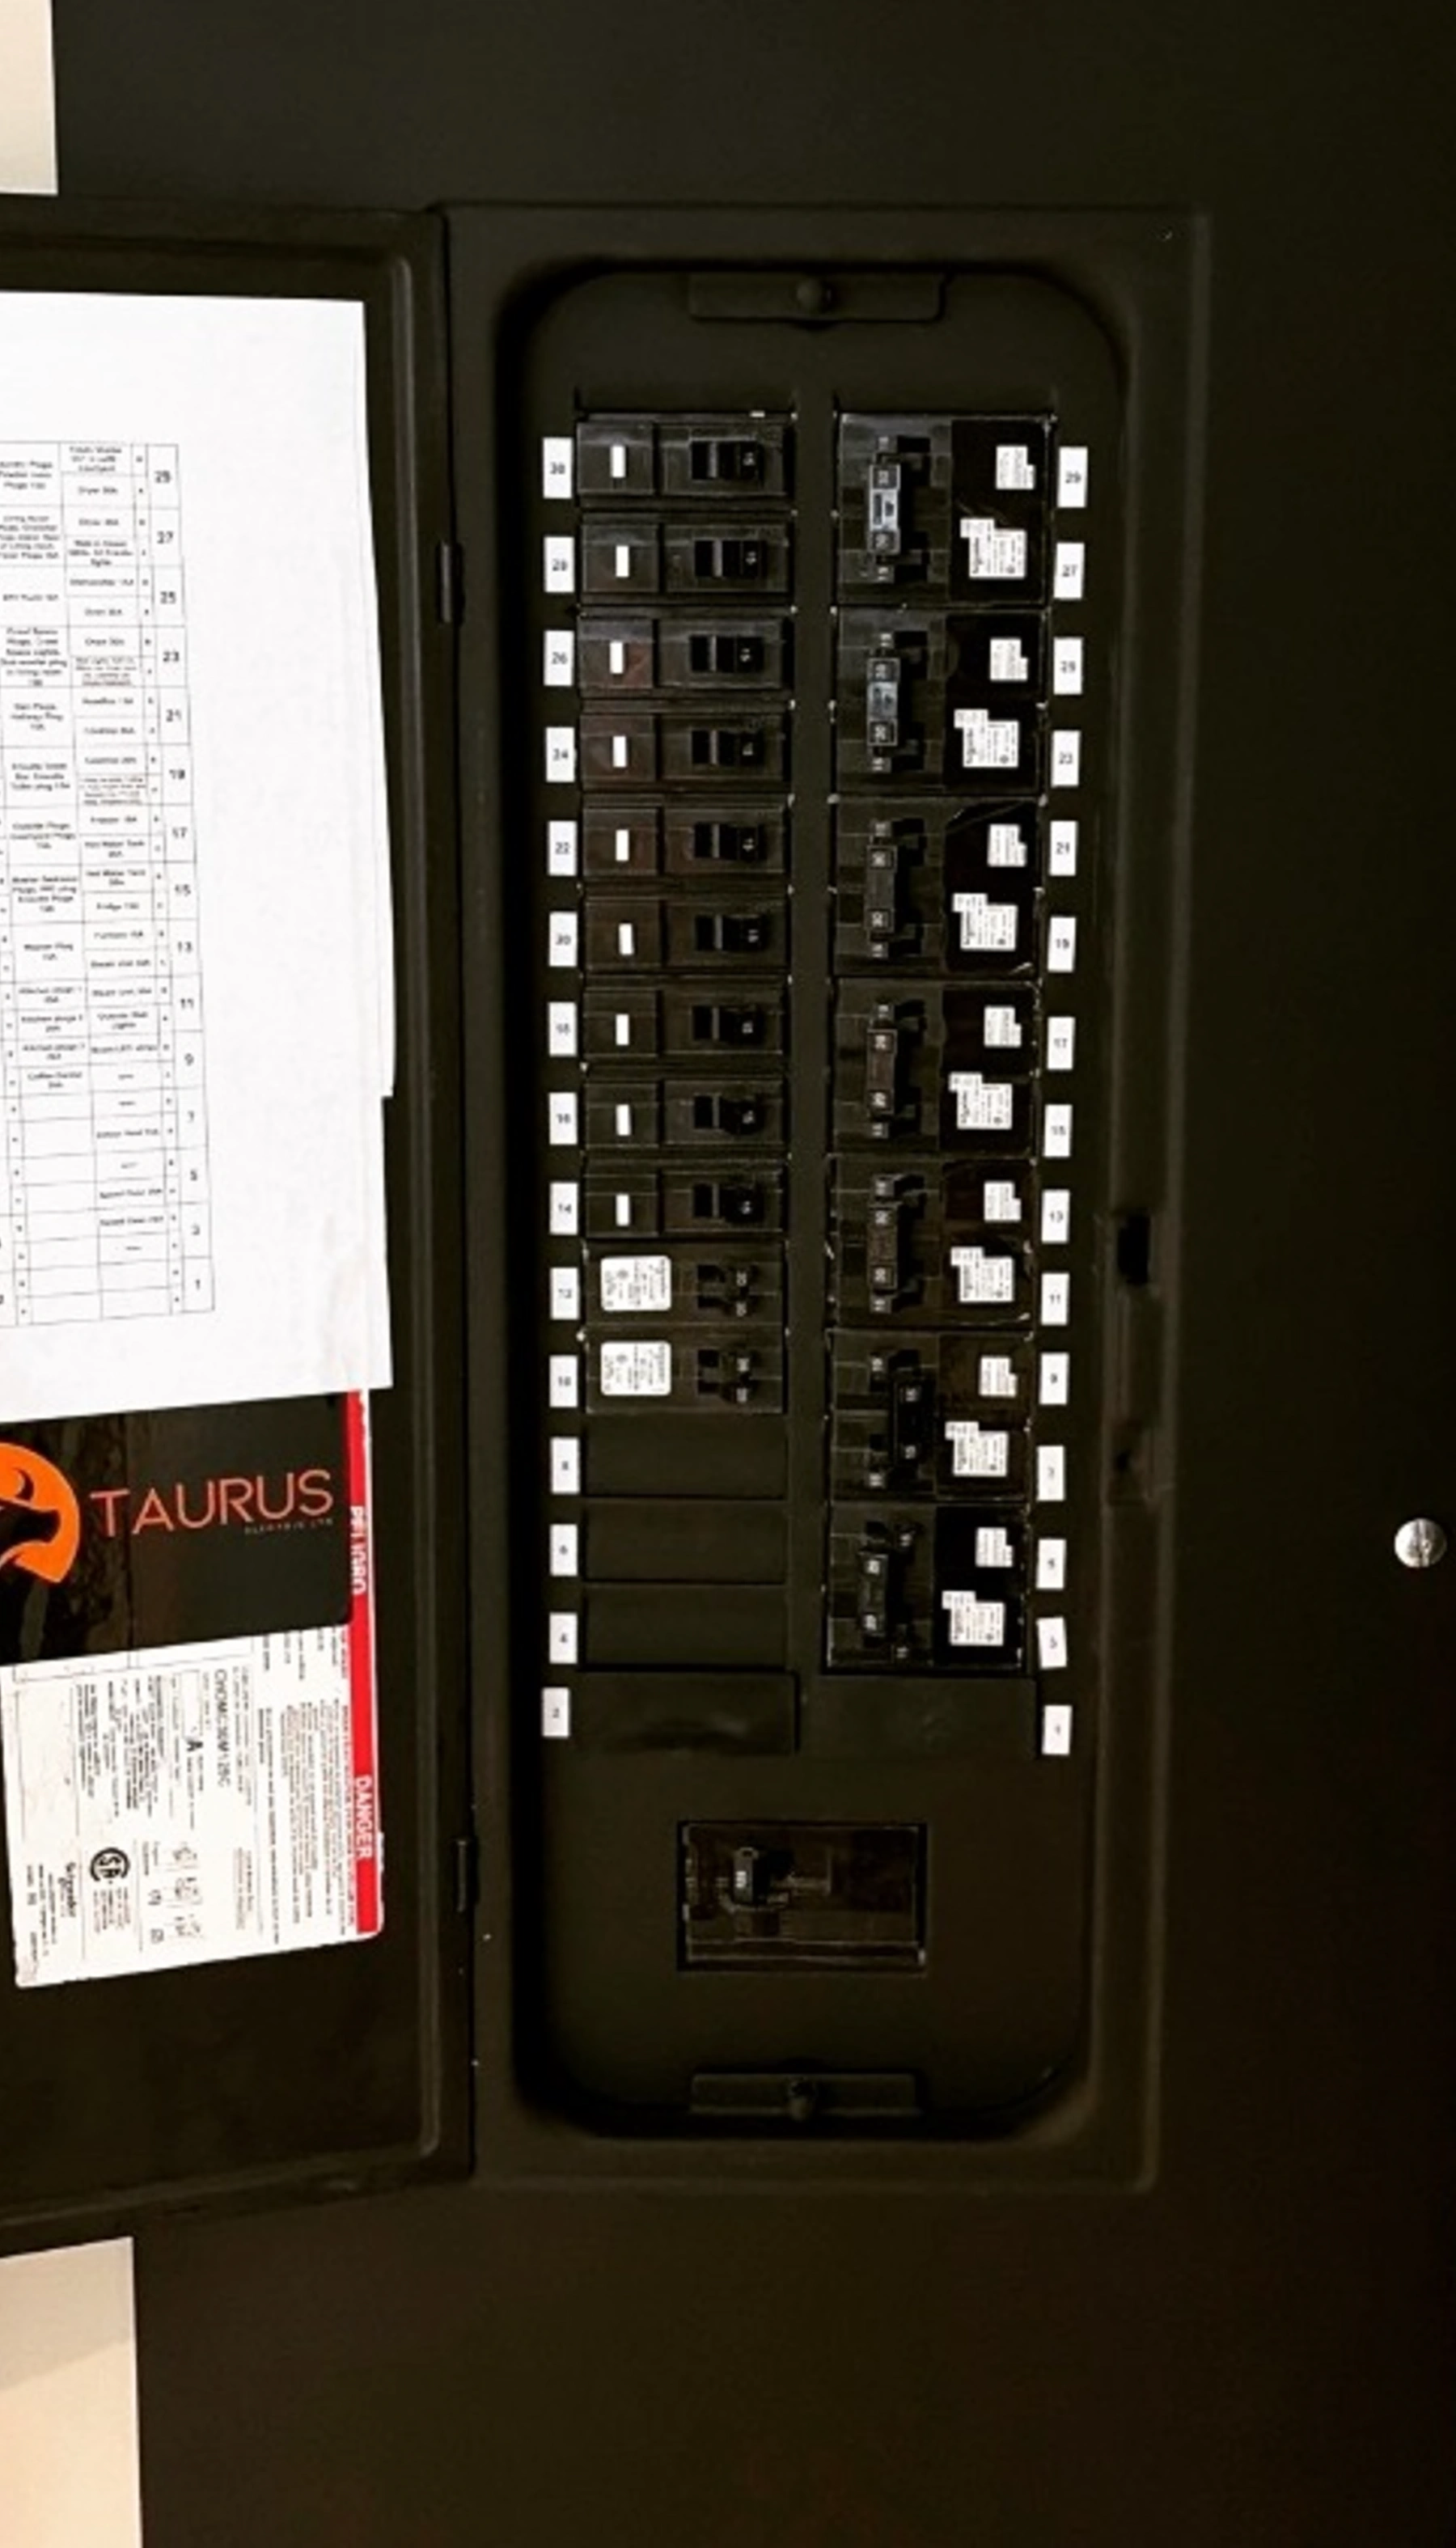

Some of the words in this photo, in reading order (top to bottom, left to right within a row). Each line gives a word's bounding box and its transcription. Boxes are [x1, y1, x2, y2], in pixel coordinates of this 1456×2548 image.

[1065, 472, 1082, 484] 29
[555, 842, 569, 854] 22
[1056, 842, 1070, 854] 21
[90, 1469, 334, 1537] TAURUS
[353, 1775, 375, 1860] DANGER
